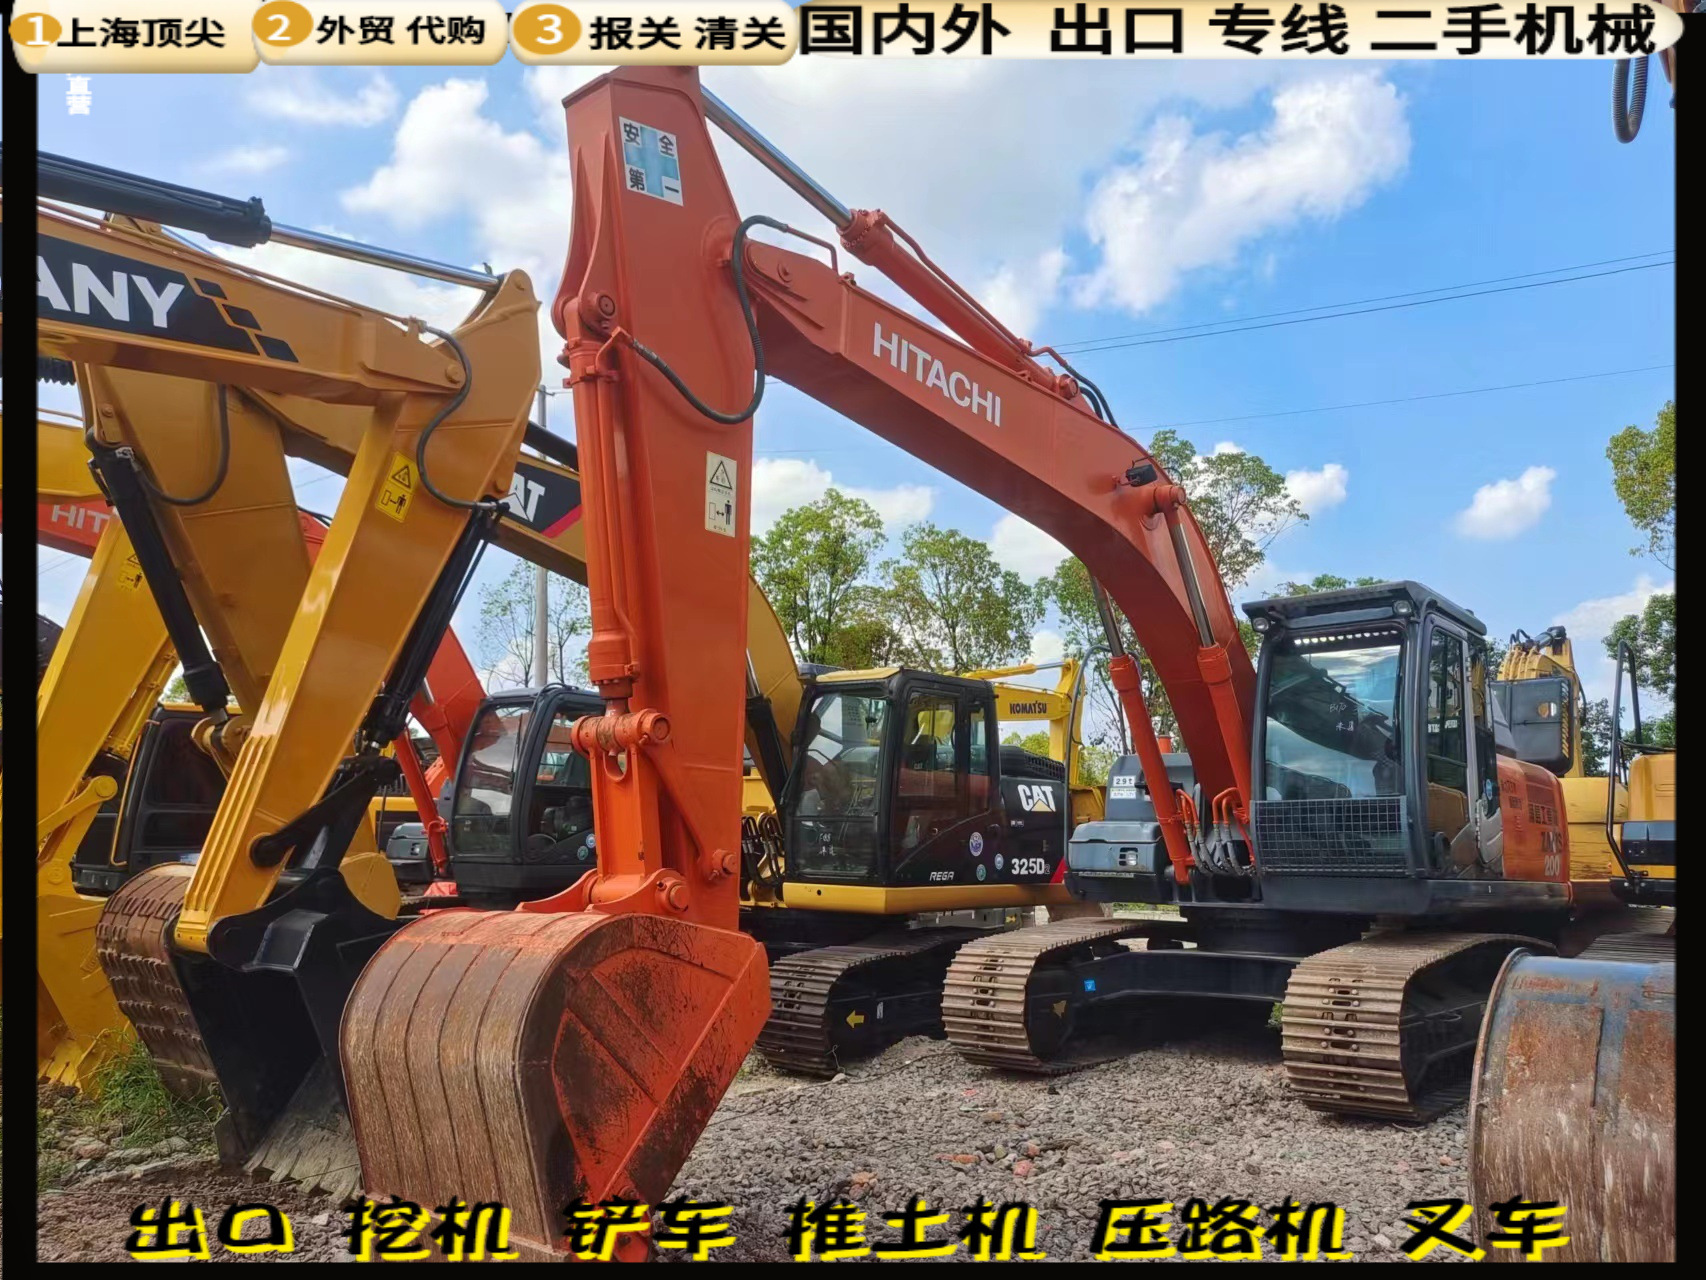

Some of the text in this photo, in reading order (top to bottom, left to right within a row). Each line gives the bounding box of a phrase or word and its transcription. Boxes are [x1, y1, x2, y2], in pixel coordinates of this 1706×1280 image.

[623, 122, 675, 157] 安全
[629, 167, 680, 193] 第一
[38, 256, 185, 328] ANY
[873, 321, 1001, 428] HITACHI
[508, 472, 545, 522] AT
[51, 504, 111, 533] HIT
[1009, 701, 1047, 714] KOMATSU
[1018, 784, 1056, 812] CAT
[929, 871, 955, 881] REGA
[1545, 855, 1560, 876] 200
